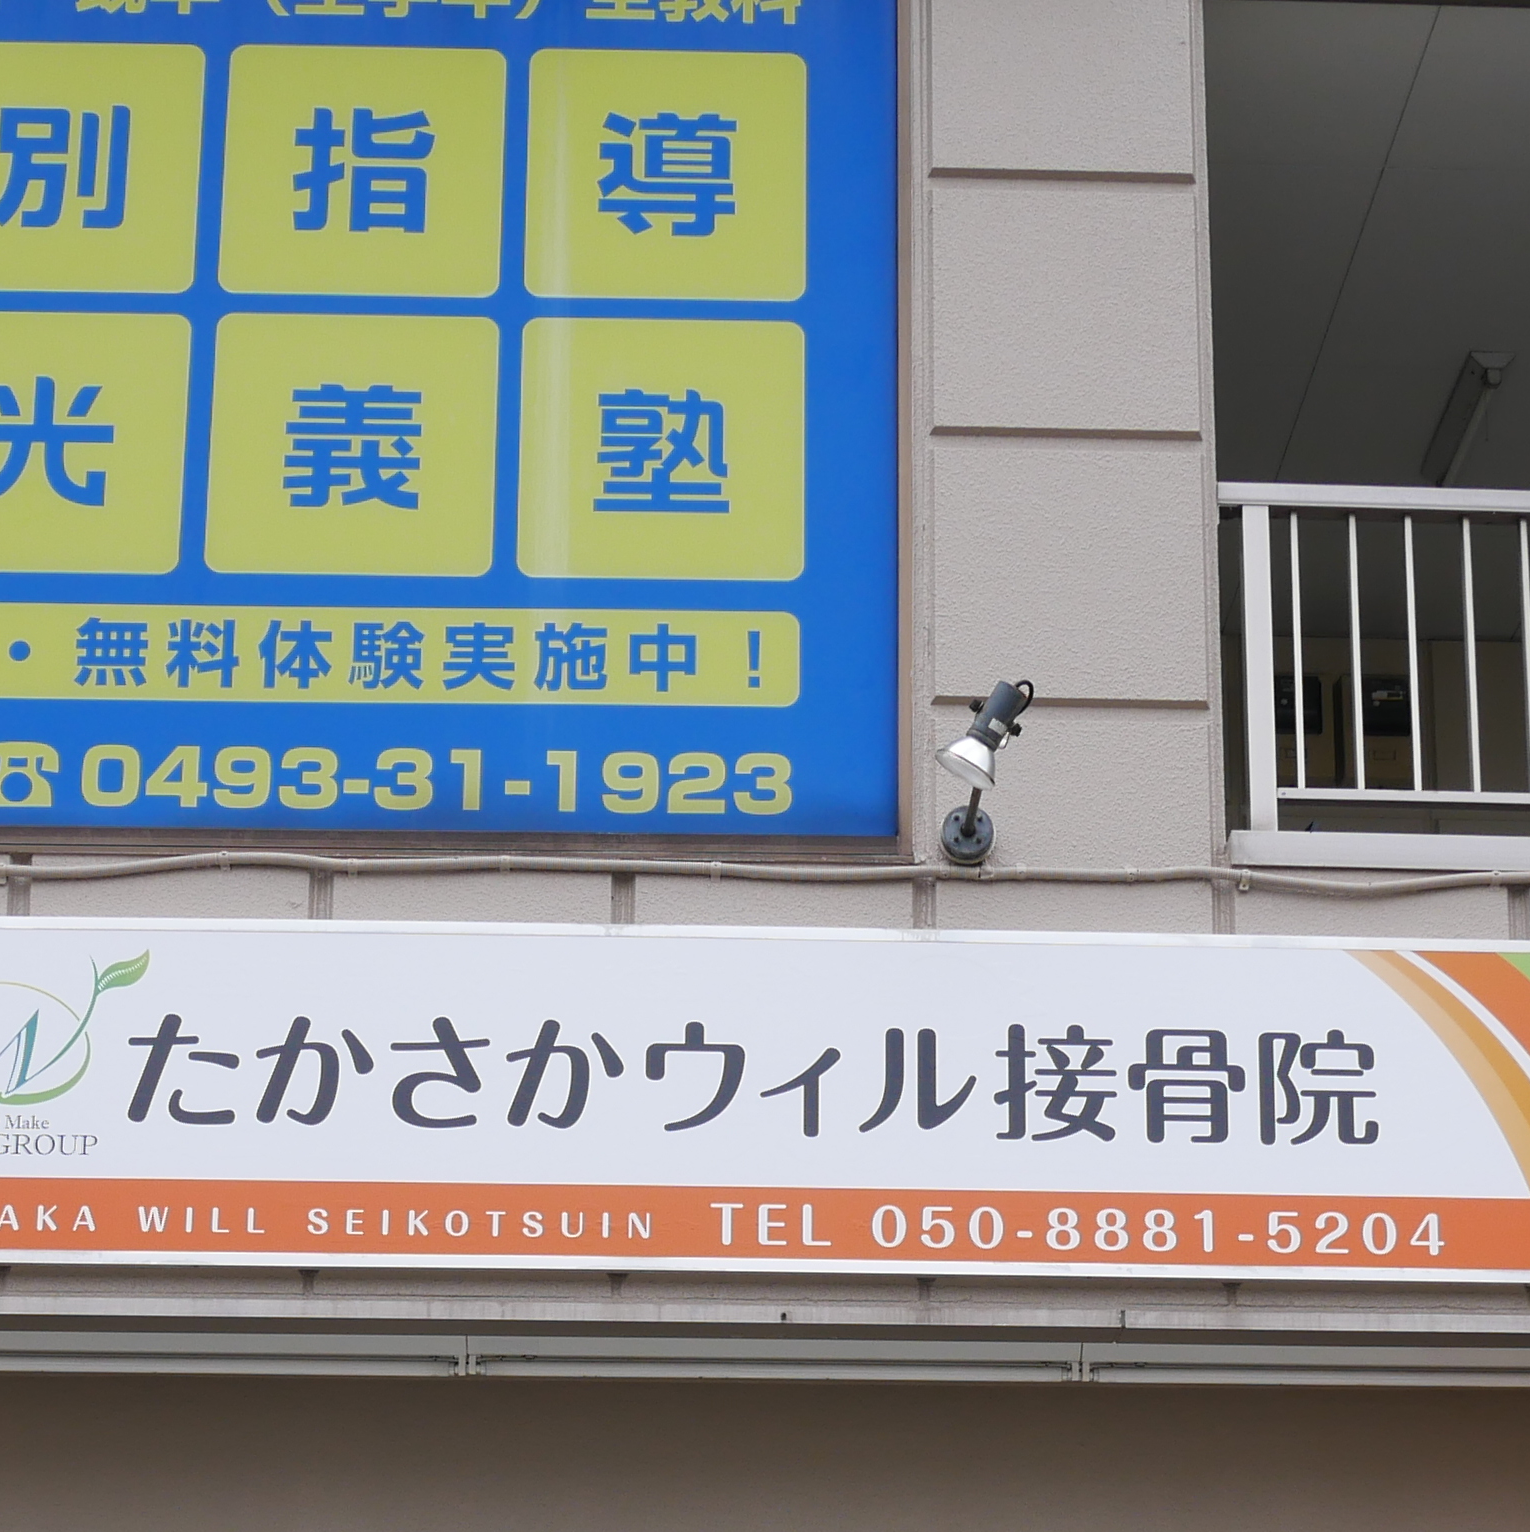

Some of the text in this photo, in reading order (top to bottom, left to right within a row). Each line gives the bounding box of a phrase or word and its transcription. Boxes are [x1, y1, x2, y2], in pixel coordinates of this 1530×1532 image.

[81, 742, 793, 816] 0493-31-1923
[126, 1012, 1380, 1146] たかさかウィル接骨院
[5, 1115, 50, 1130] Make
[137, 1206, 267, 1236] WILL
[307, 1207, 653, 1241] SEIKOTSUIN
[710, 1202, 833, 1247] TEL
[871, 1203, 1447, 1258] 050-8881-5204
